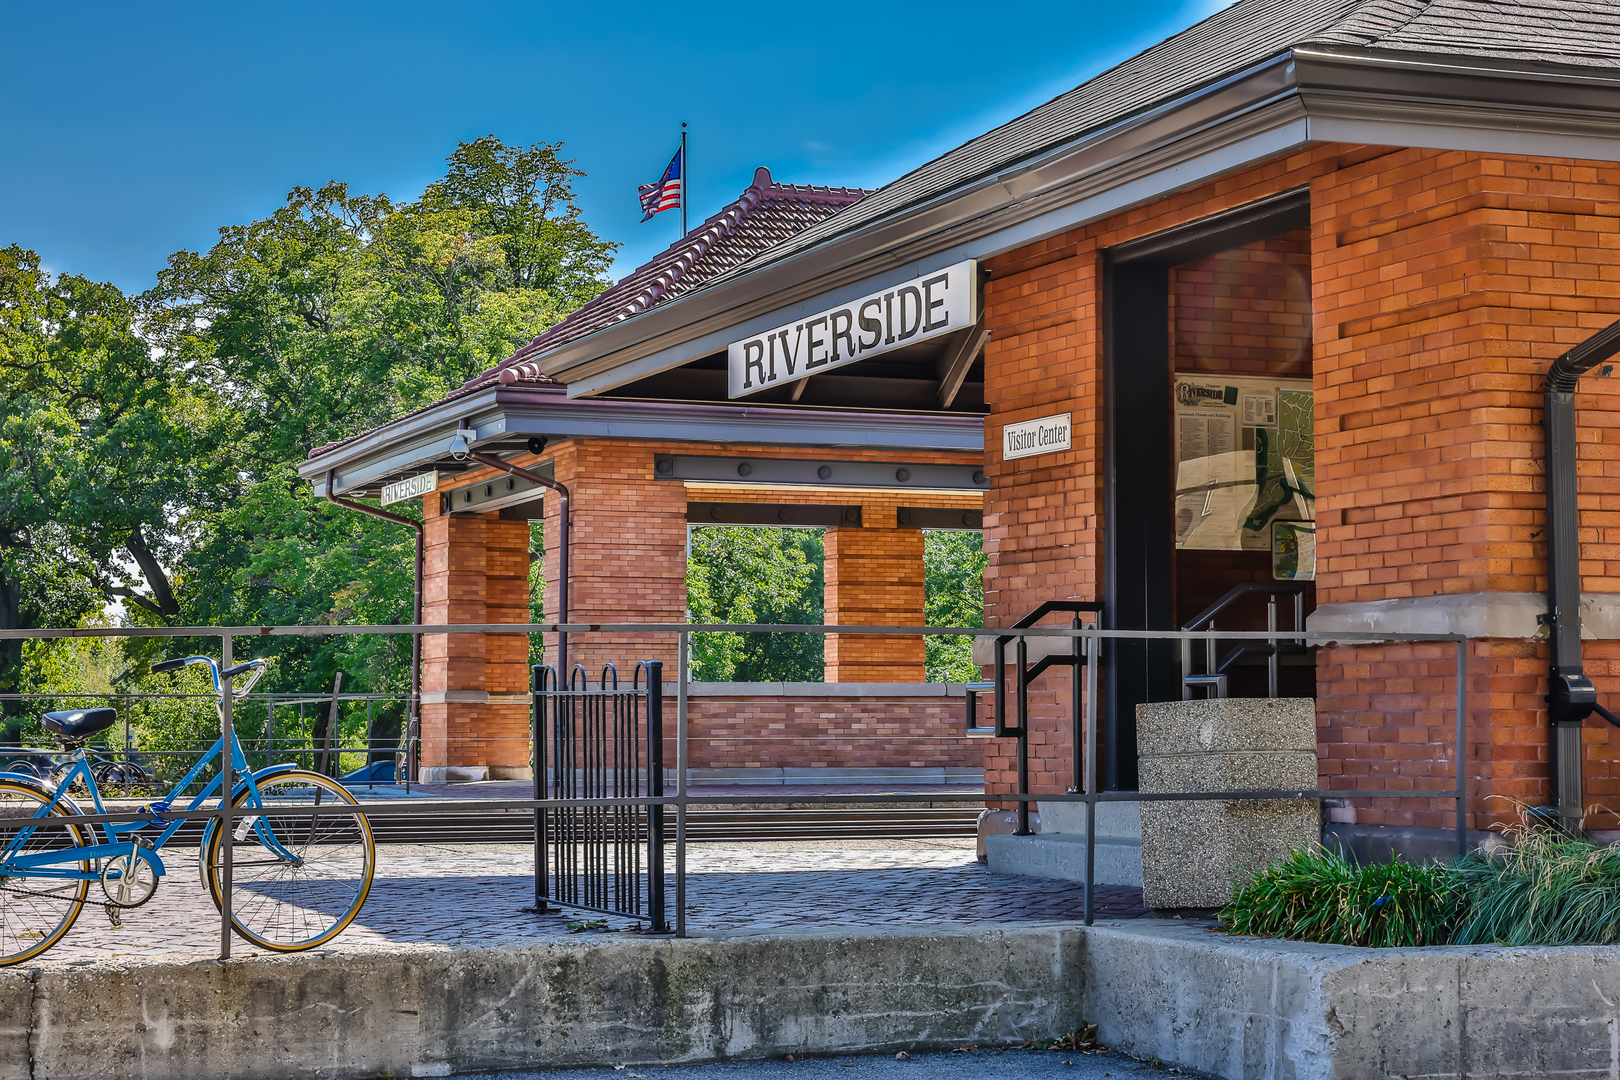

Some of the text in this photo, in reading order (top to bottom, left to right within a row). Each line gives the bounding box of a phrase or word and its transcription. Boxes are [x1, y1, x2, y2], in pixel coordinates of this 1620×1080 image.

[743, 272, 949, 389] RIVERSIDE
[1007, 424, 1068, 452] Visitor Center
[385, 473, 433, 503] RIVERSIDE
